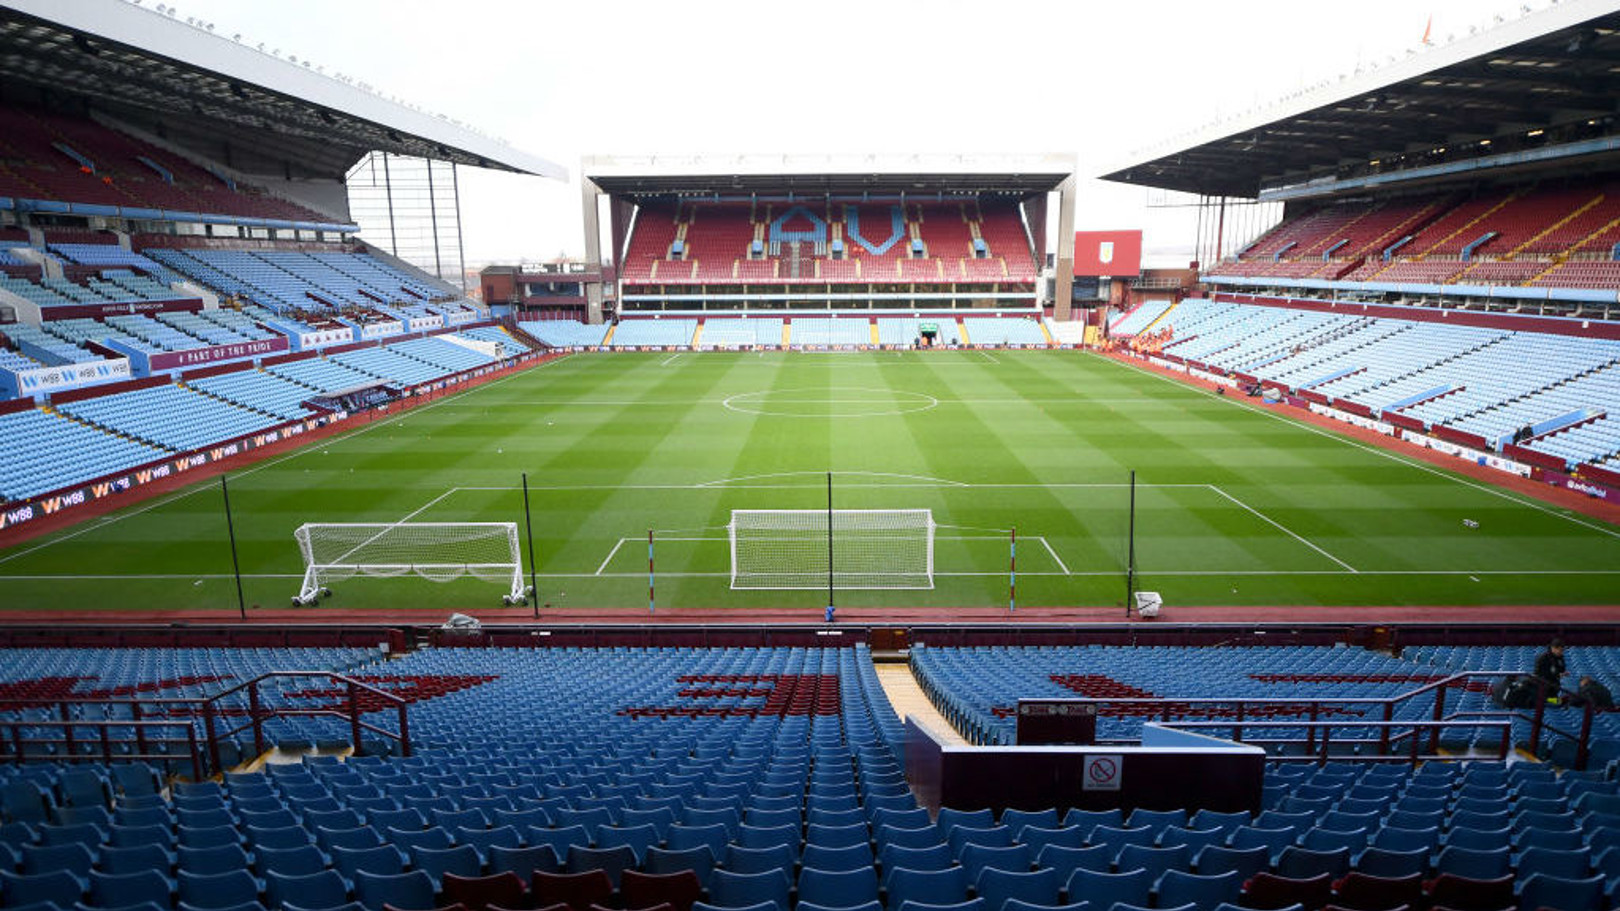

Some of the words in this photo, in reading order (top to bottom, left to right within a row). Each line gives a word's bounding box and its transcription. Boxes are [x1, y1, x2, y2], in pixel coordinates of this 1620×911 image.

[188, 350, 210, 362] PART
[214, 348, 225, 358] OF
[228, 346, 244, 356] THE
[248, 342, 272, 353] PRIDE
[7, 506, 33, 524] W88
[62, 491, 85, 507] W88
[152, 465, 170, 478] W88
